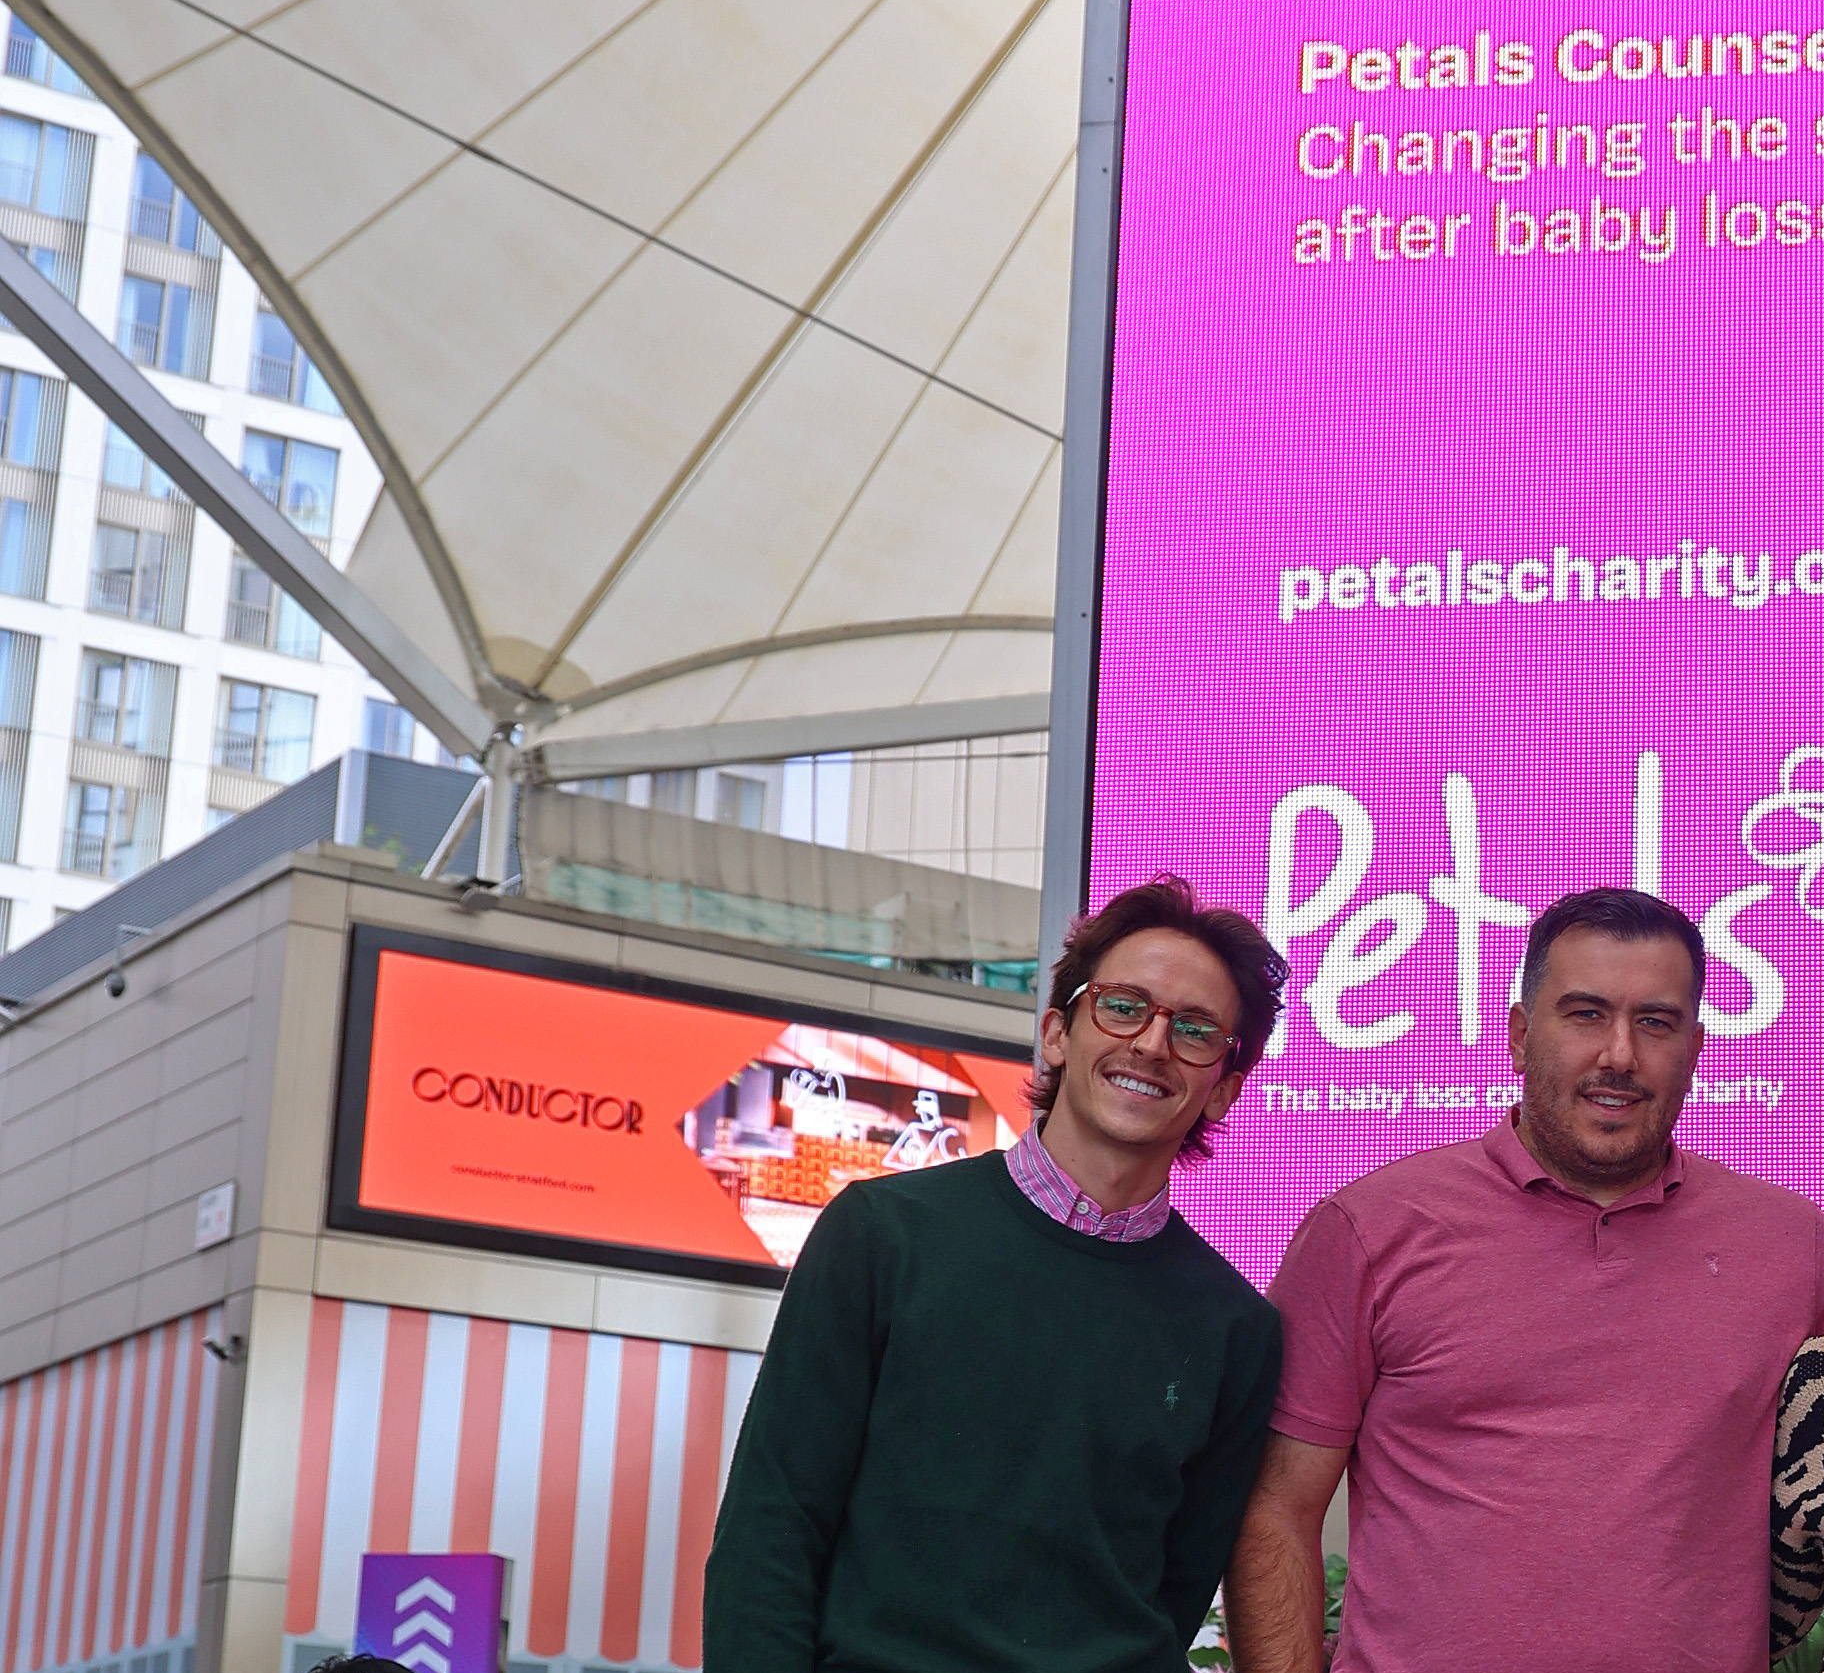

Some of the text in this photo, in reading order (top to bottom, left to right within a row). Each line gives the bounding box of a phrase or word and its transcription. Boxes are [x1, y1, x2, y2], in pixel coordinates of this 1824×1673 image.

[1297, 27, 1534, 96] Petals
[1296, 112, 1647, 185] Changing
[1667, 105, 1788, 165] the
[1293, 203, 1471, 266] after
[1492, 193, 1677, 263] baby
[1263, 748, 1786, 1059] Petls
[411, 1065, 644, 1136] CONDUCTOR
[1261, 1080, 1320, 1112] The
[1328, 1079, 1407, 1120] baby
[1413, 1081, 1477, 1109] loss
[1683, 1074, 1784, 1113] harity
